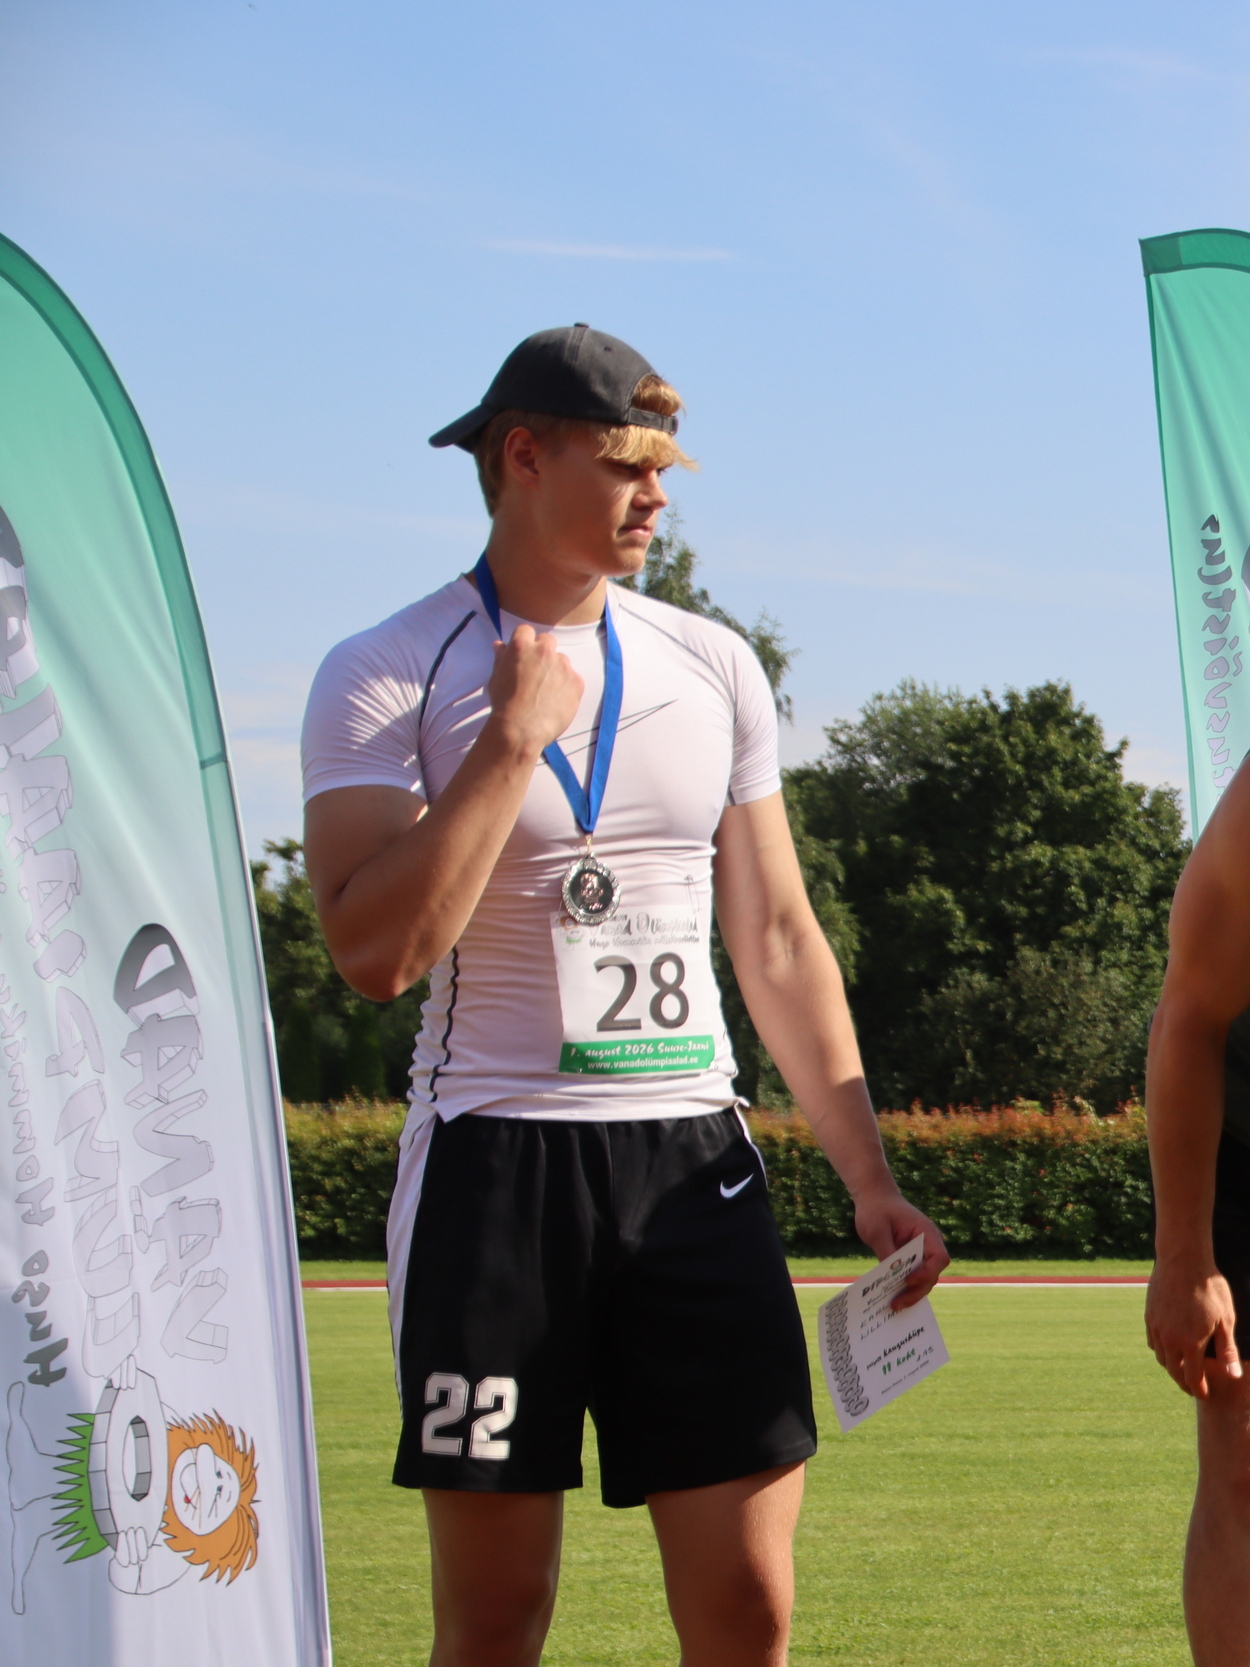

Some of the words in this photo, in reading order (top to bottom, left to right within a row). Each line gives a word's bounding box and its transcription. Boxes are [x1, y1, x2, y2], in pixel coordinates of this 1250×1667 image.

[593, 952, 689, 1032] 28
[585, 1045, 621, 1059] august
[625, 1042, 654, 1055] 2026
[657, 1040, 709, 1054] Suure-Jaani
[587, 1056, 699, 1069] www.vanadolümpiaalad.ee
[896, 1348, 916, 1367] koht
[422, 1372, 519, 1461] 22
